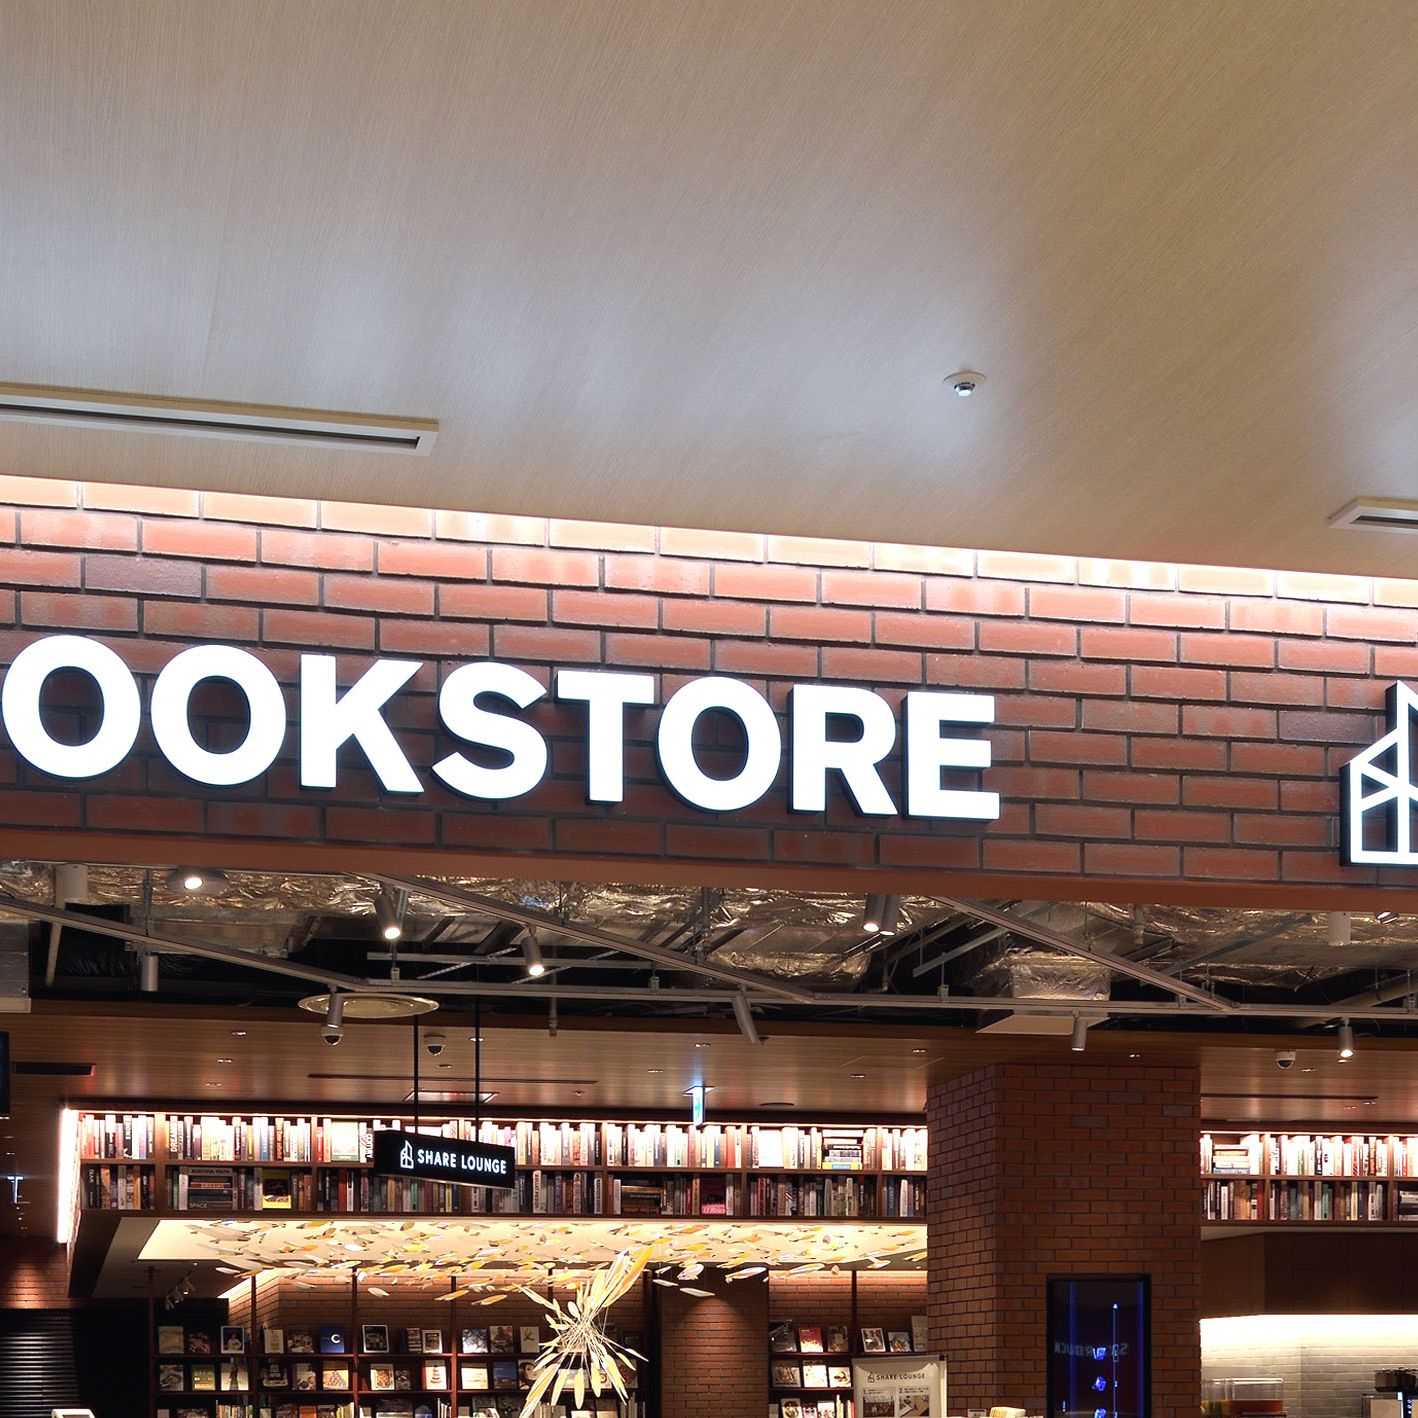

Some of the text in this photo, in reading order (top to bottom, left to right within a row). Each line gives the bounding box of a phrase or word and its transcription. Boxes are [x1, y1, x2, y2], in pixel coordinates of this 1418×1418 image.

[417, 1149, 507, 1175] SHARE LOUNGE
[876, 1373, 897, 1381] SHARE
